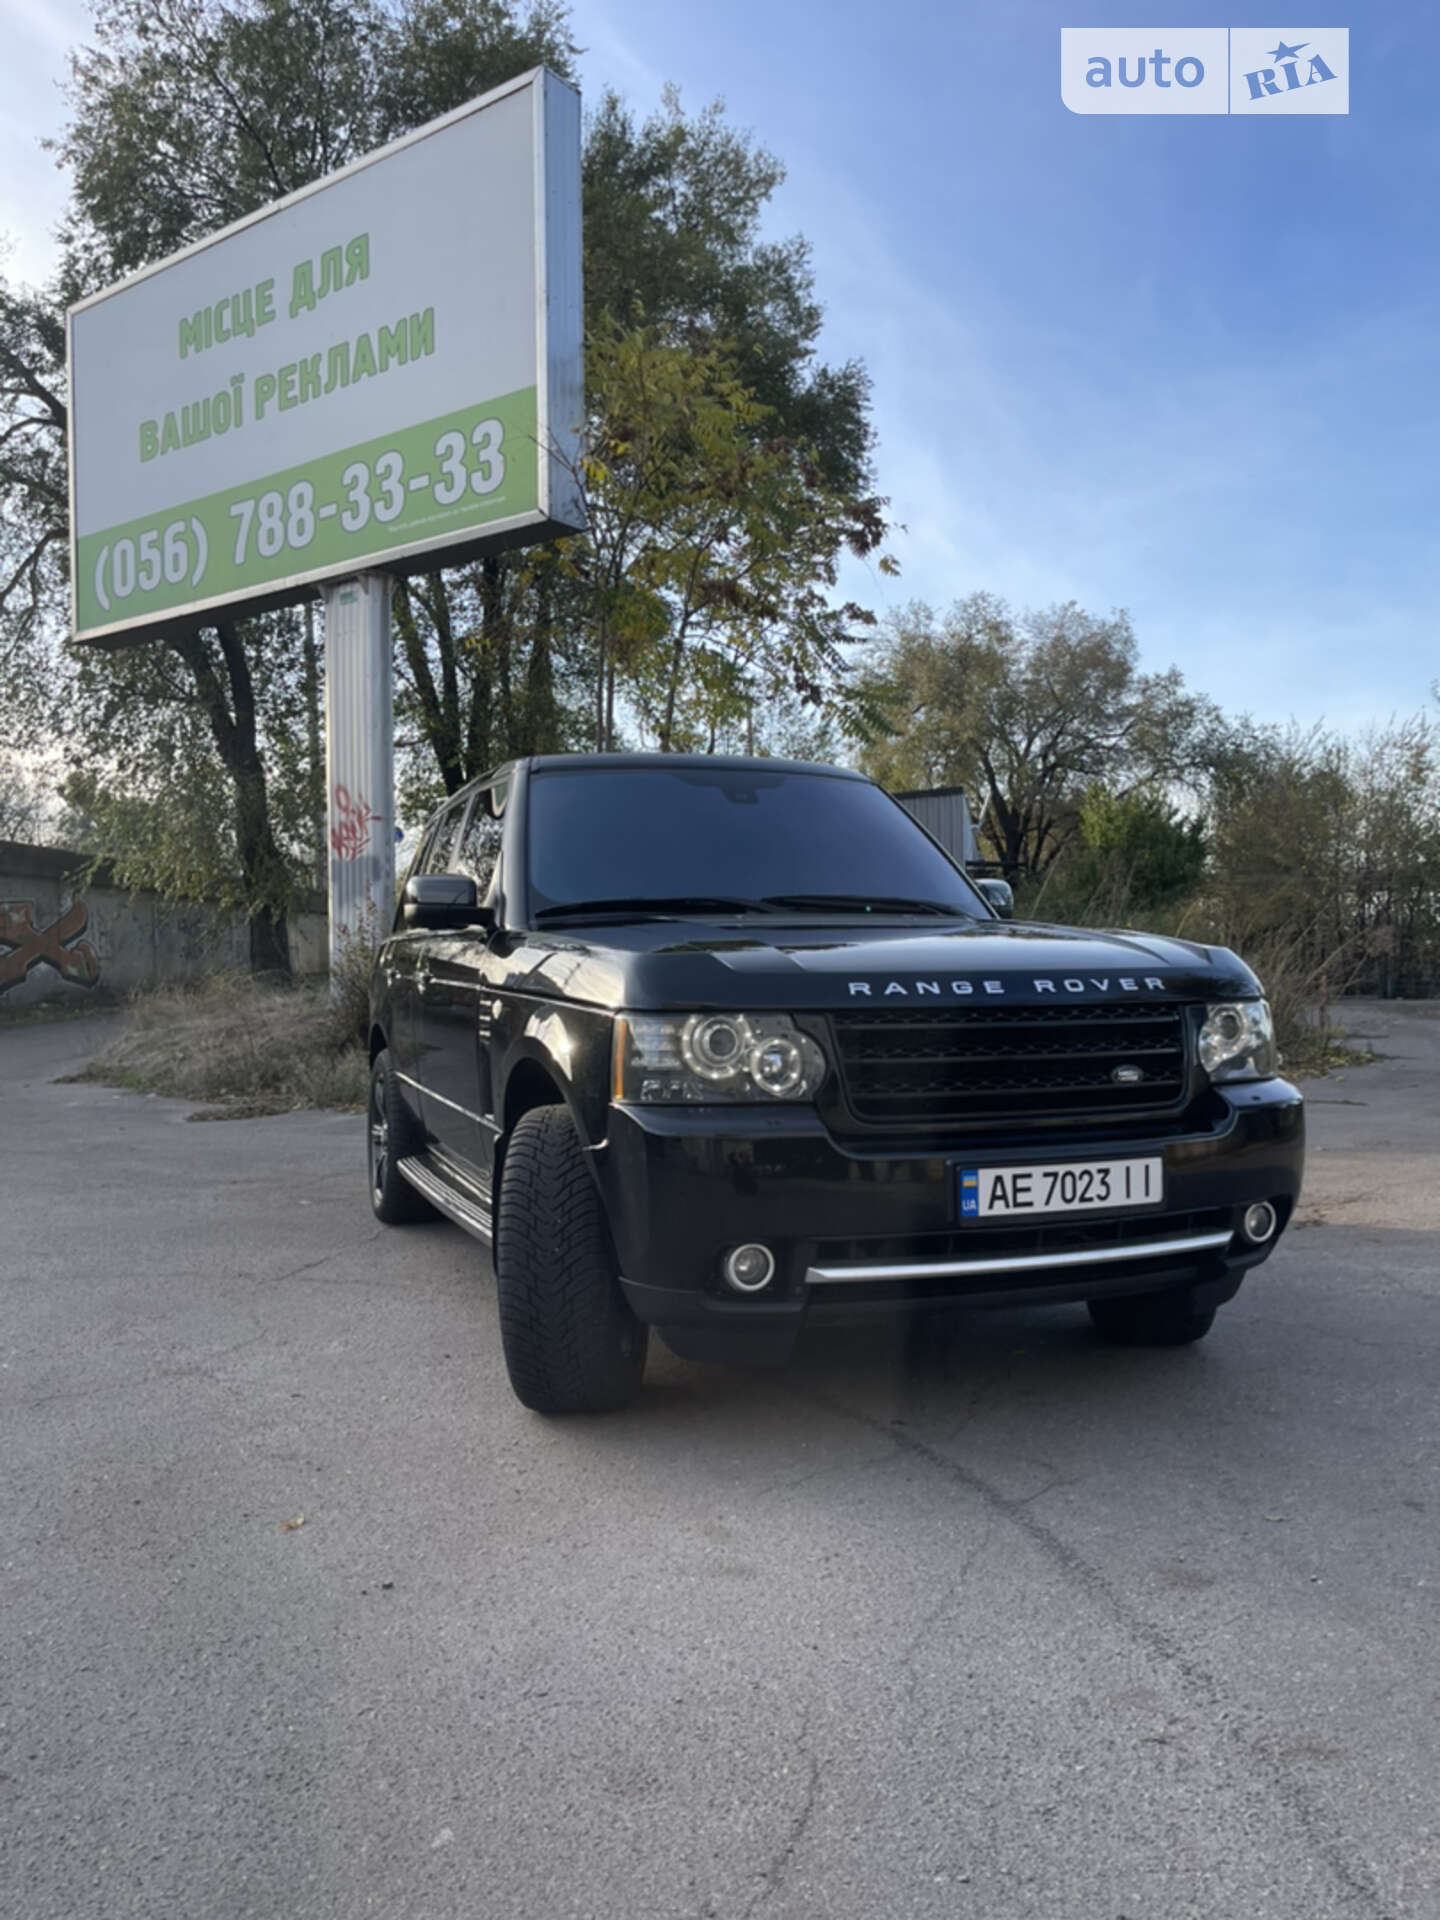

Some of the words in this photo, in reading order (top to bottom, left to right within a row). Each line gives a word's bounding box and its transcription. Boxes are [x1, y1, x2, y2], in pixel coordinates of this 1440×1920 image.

[178, 278, 277, 360] МІСЦЕ
[288, 232, 370, 320] ДЛЯ
[138, 373, 245, 463] ВАШОЇ
[254, 306, 436, 421] РЕКЛАМИ
[94, 515, 209, 611] (056)
[228, 416, 506, 566] 788-33-33
[848, 980, 1005, 996] RANGE
[1033, 976, 1167, 993] ROVER
[962, 1199, 977, 1212] UA
[987, 1172, 1034, 1210] AE
[1042, 1167, 1111, 1207] 7023
